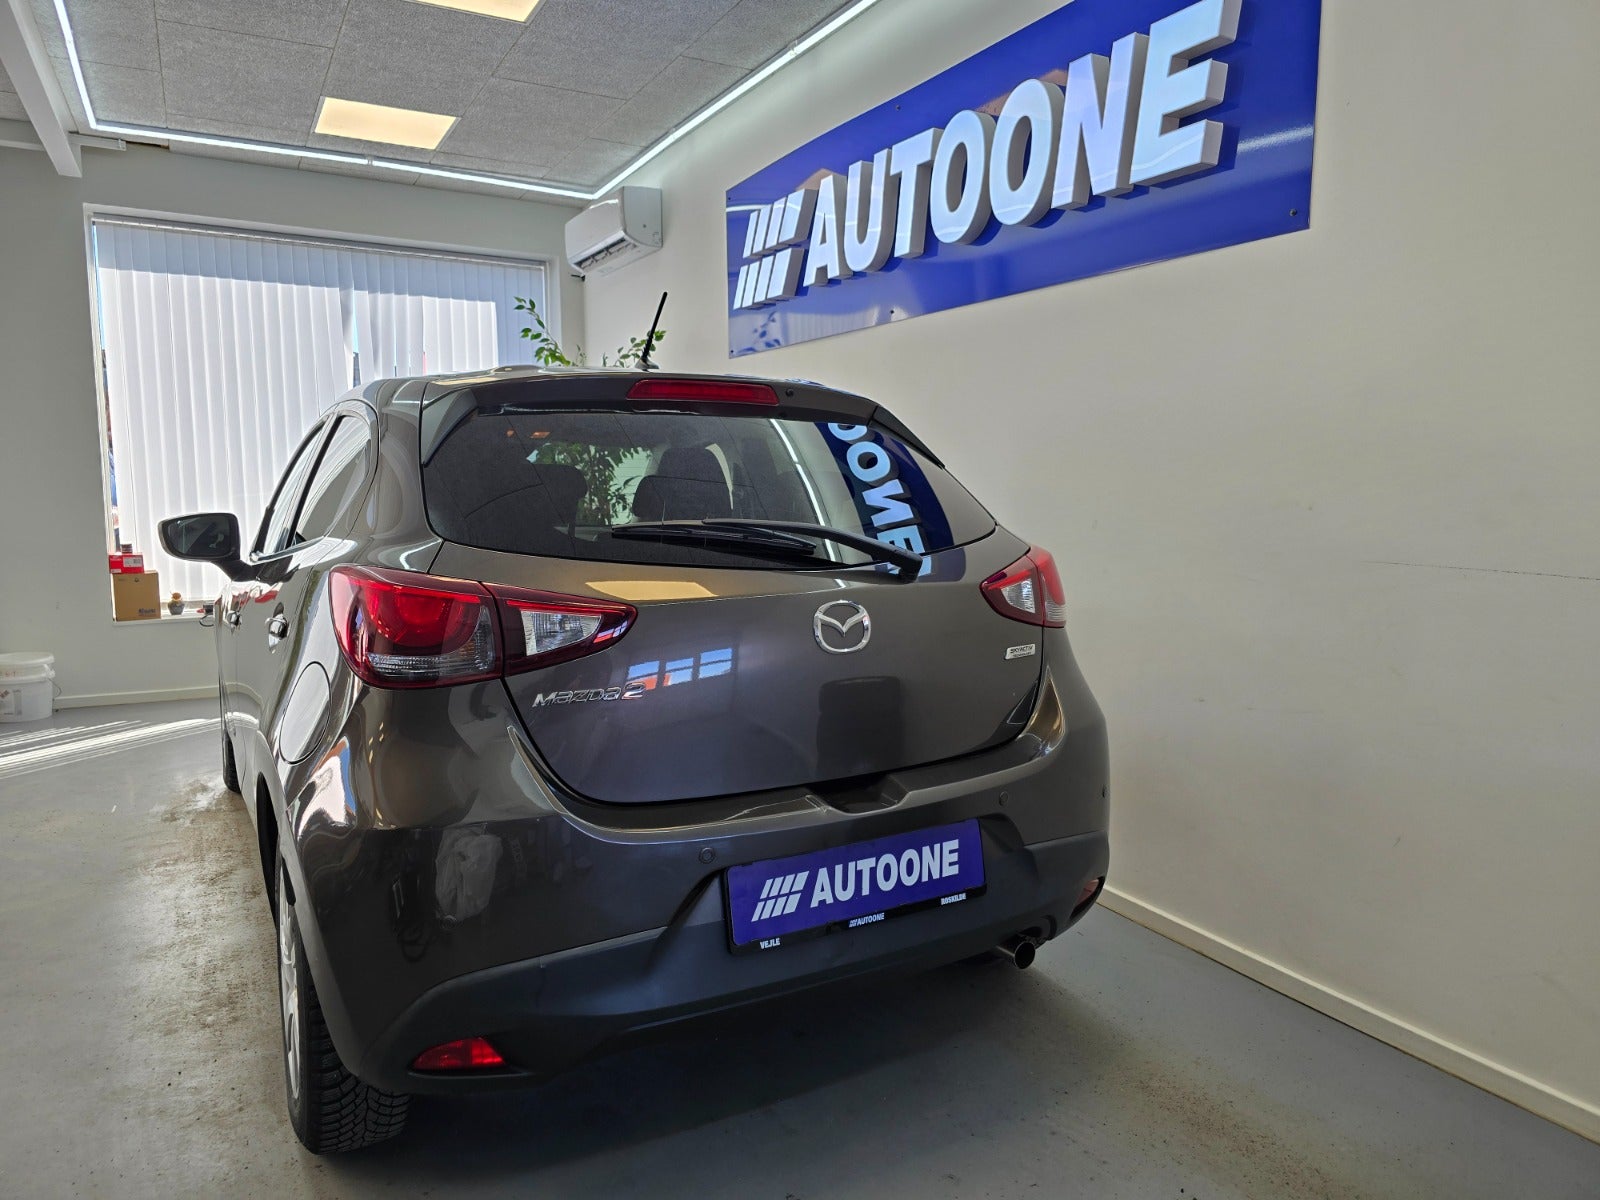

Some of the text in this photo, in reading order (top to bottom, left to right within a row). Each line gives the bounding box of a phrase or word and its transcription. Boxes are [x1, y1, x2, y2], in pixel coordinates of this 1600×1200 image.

[803, 0, 1241, 288] AUTOONE
[810, 839, 960, 908] AUTOONE
[857, 912, 885, 926] AUTOONE
[759, 938, 781, 950] VEJLE
